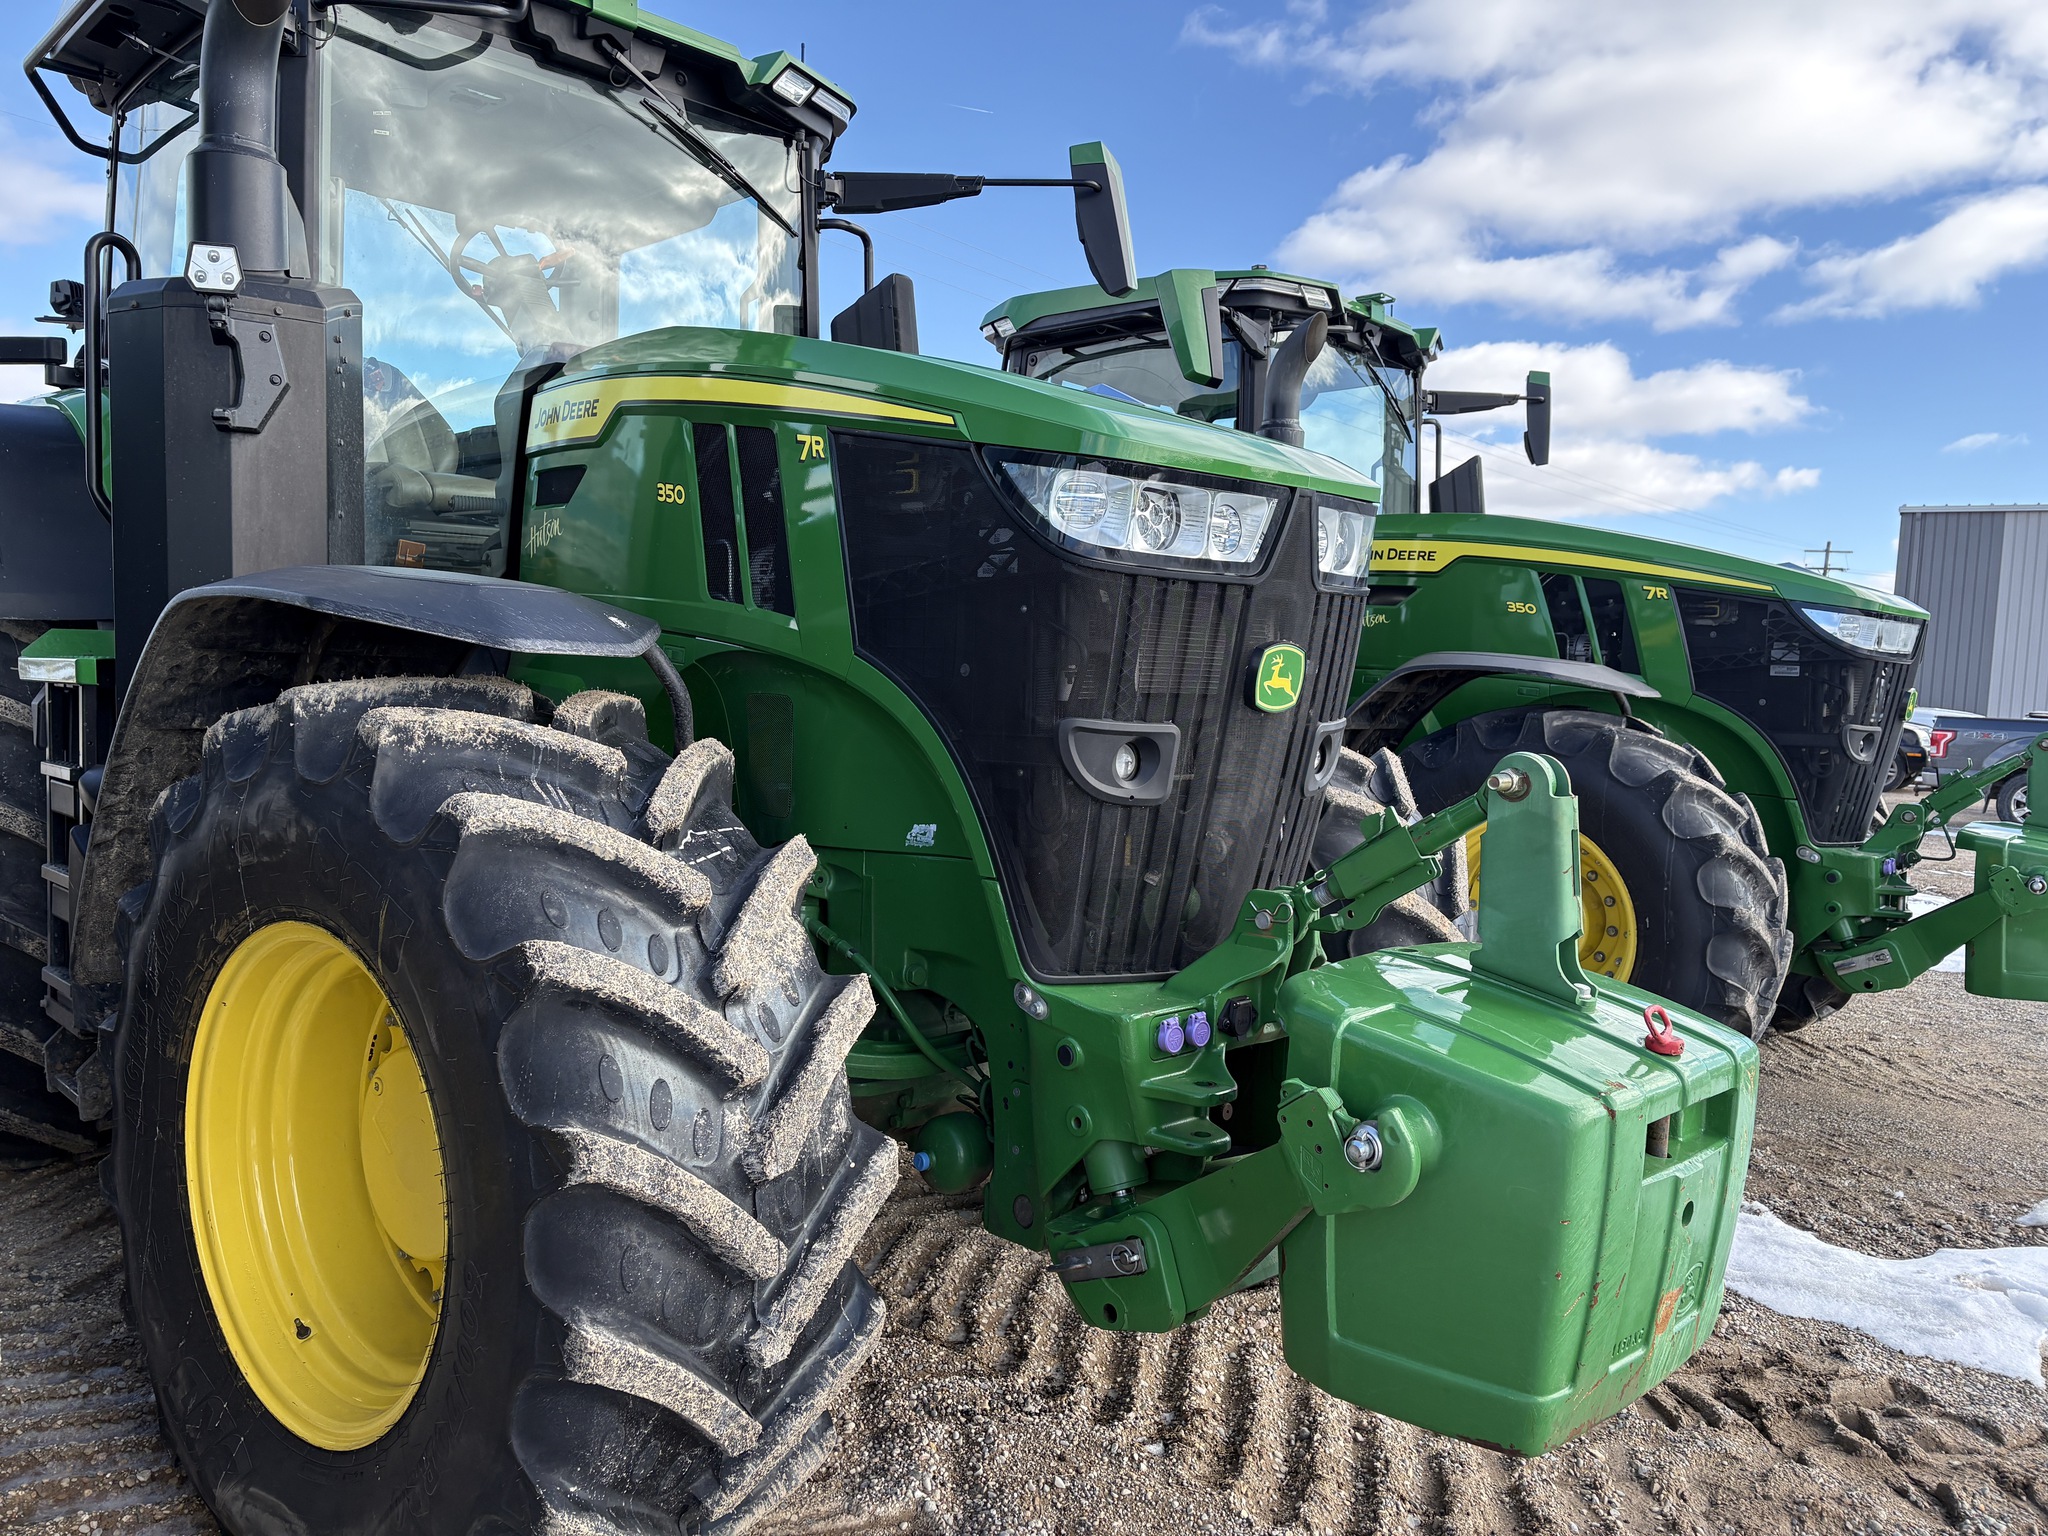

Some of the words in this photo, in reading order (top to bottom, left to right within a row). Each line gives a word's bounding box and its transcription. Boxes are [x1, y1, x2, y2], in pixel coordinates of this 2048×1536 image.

[534, 404, 561, 430] JOHN
[561, 398, 600, 422] DEERE
[796, 434, 826, 462] 7R
[656, 482, 686, 505] 350
[525, 511, 564, 558] Hutson
[1387, 548, 1437, 561] DEERE
[1642, 585, 1669, 600] 7R
[1506, 601, 1537, 615] 350
[1362, 610, 1391, 627] tson
